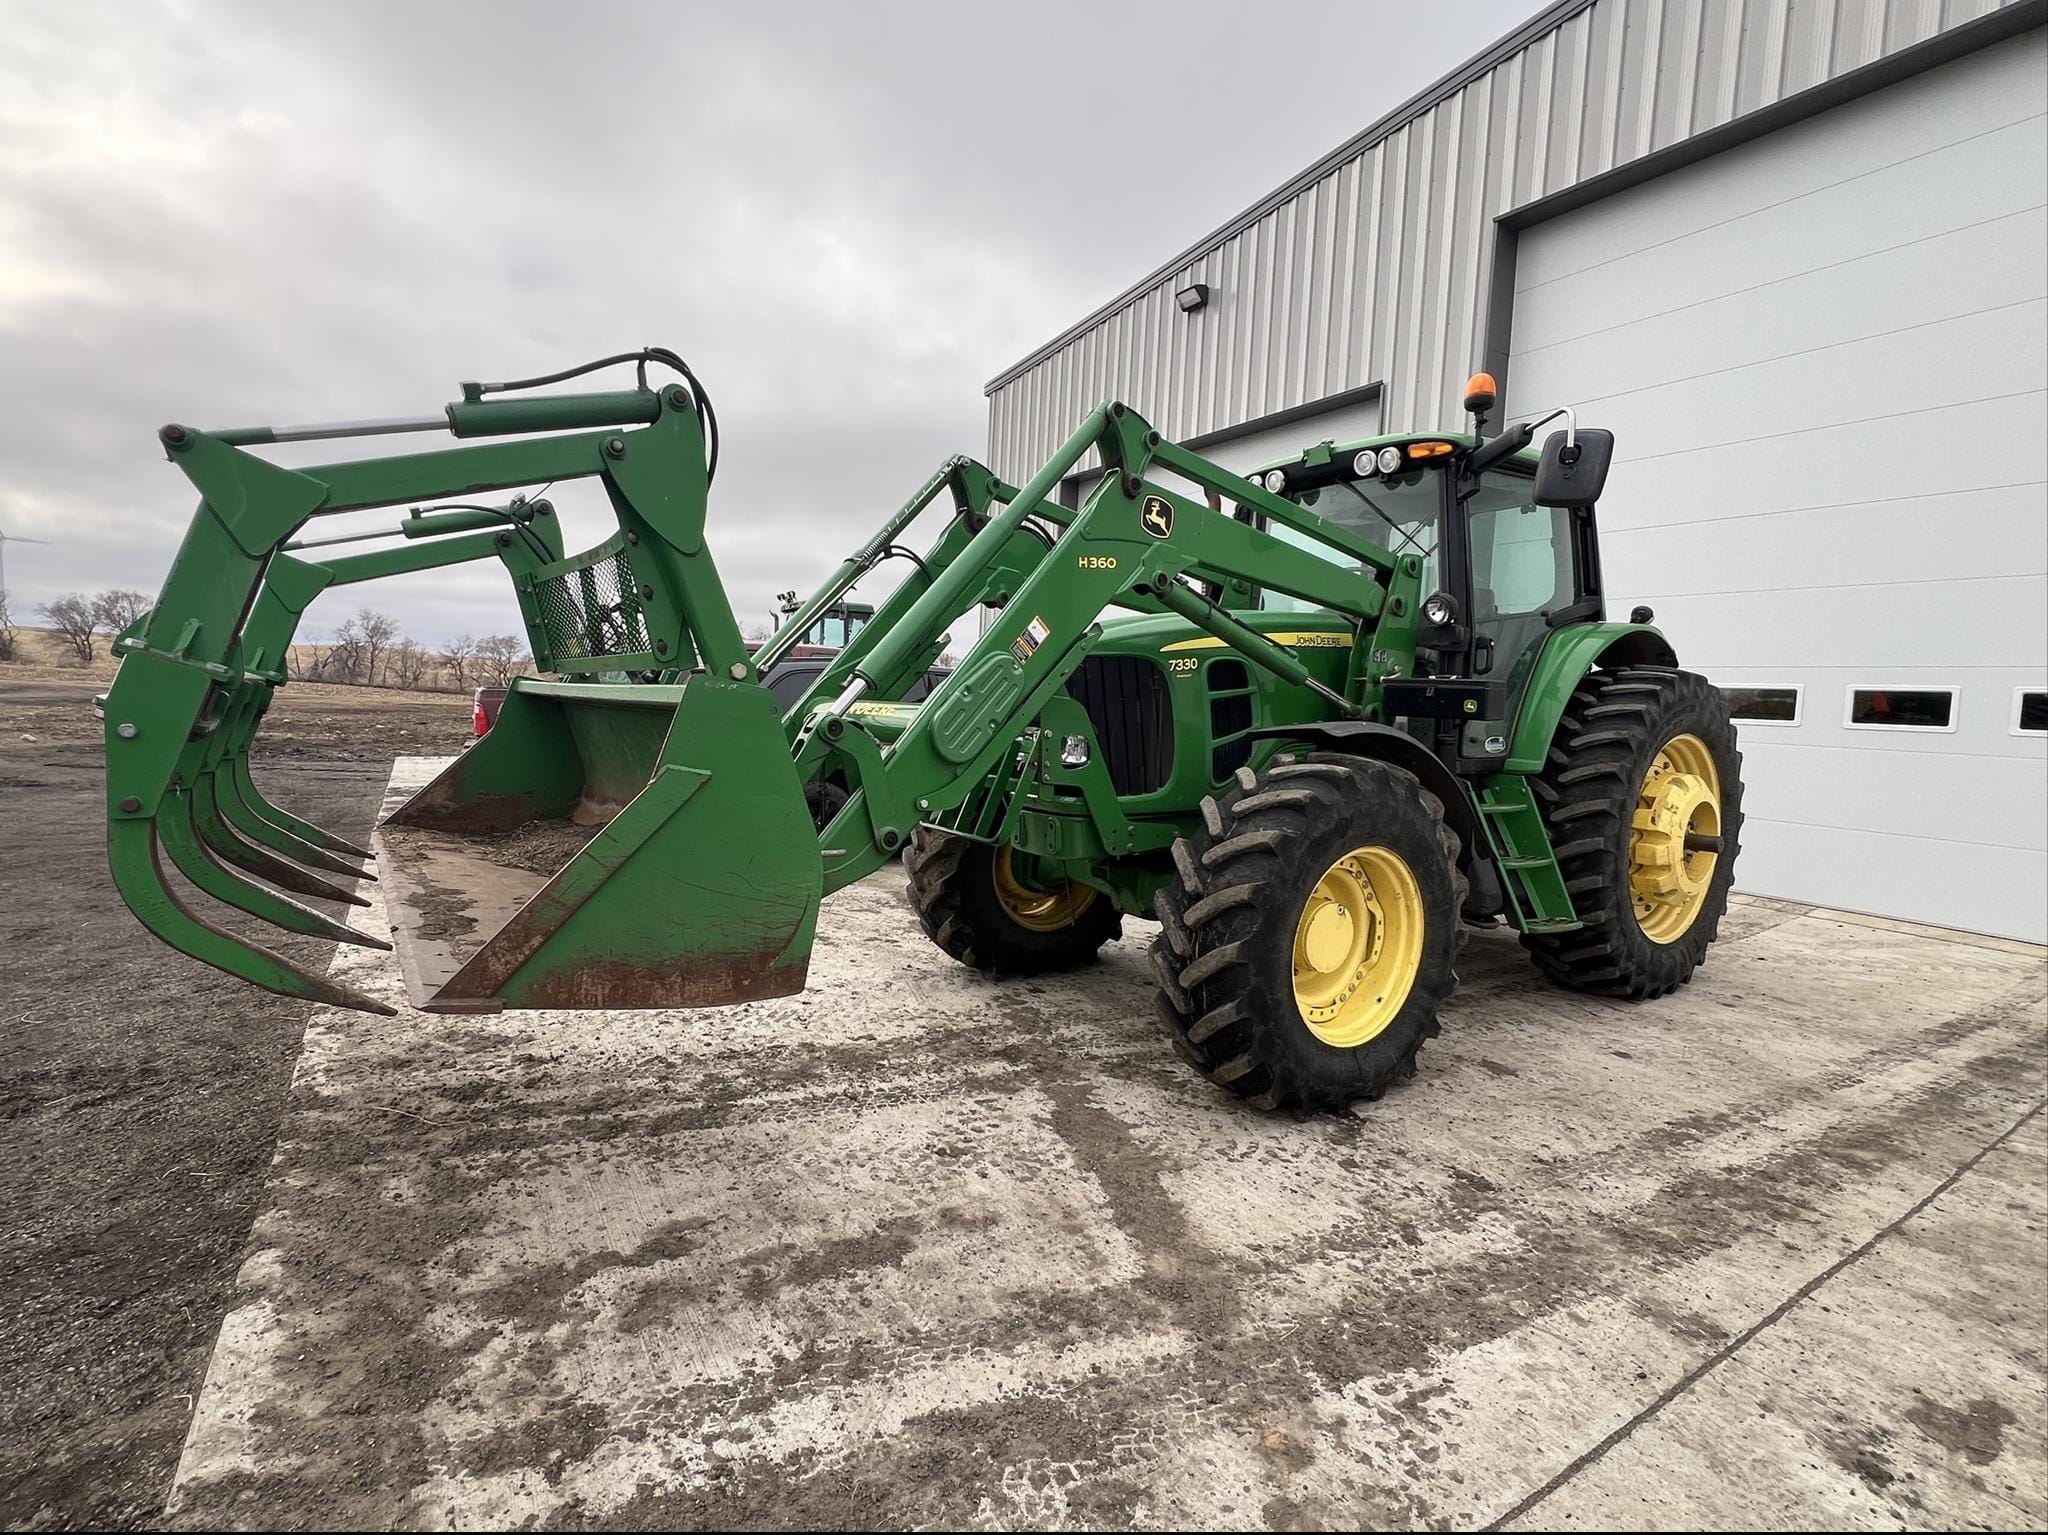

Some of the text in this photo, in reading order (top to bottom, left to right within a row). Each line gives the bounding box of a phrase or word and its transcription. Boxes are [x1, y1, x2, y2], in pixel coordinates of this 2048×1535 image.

[1078, 556, 1117, 569] H360
[1295, 634, 1342, 646] JOHN DEERE
[1168, 657, 1199, 672] 7330
